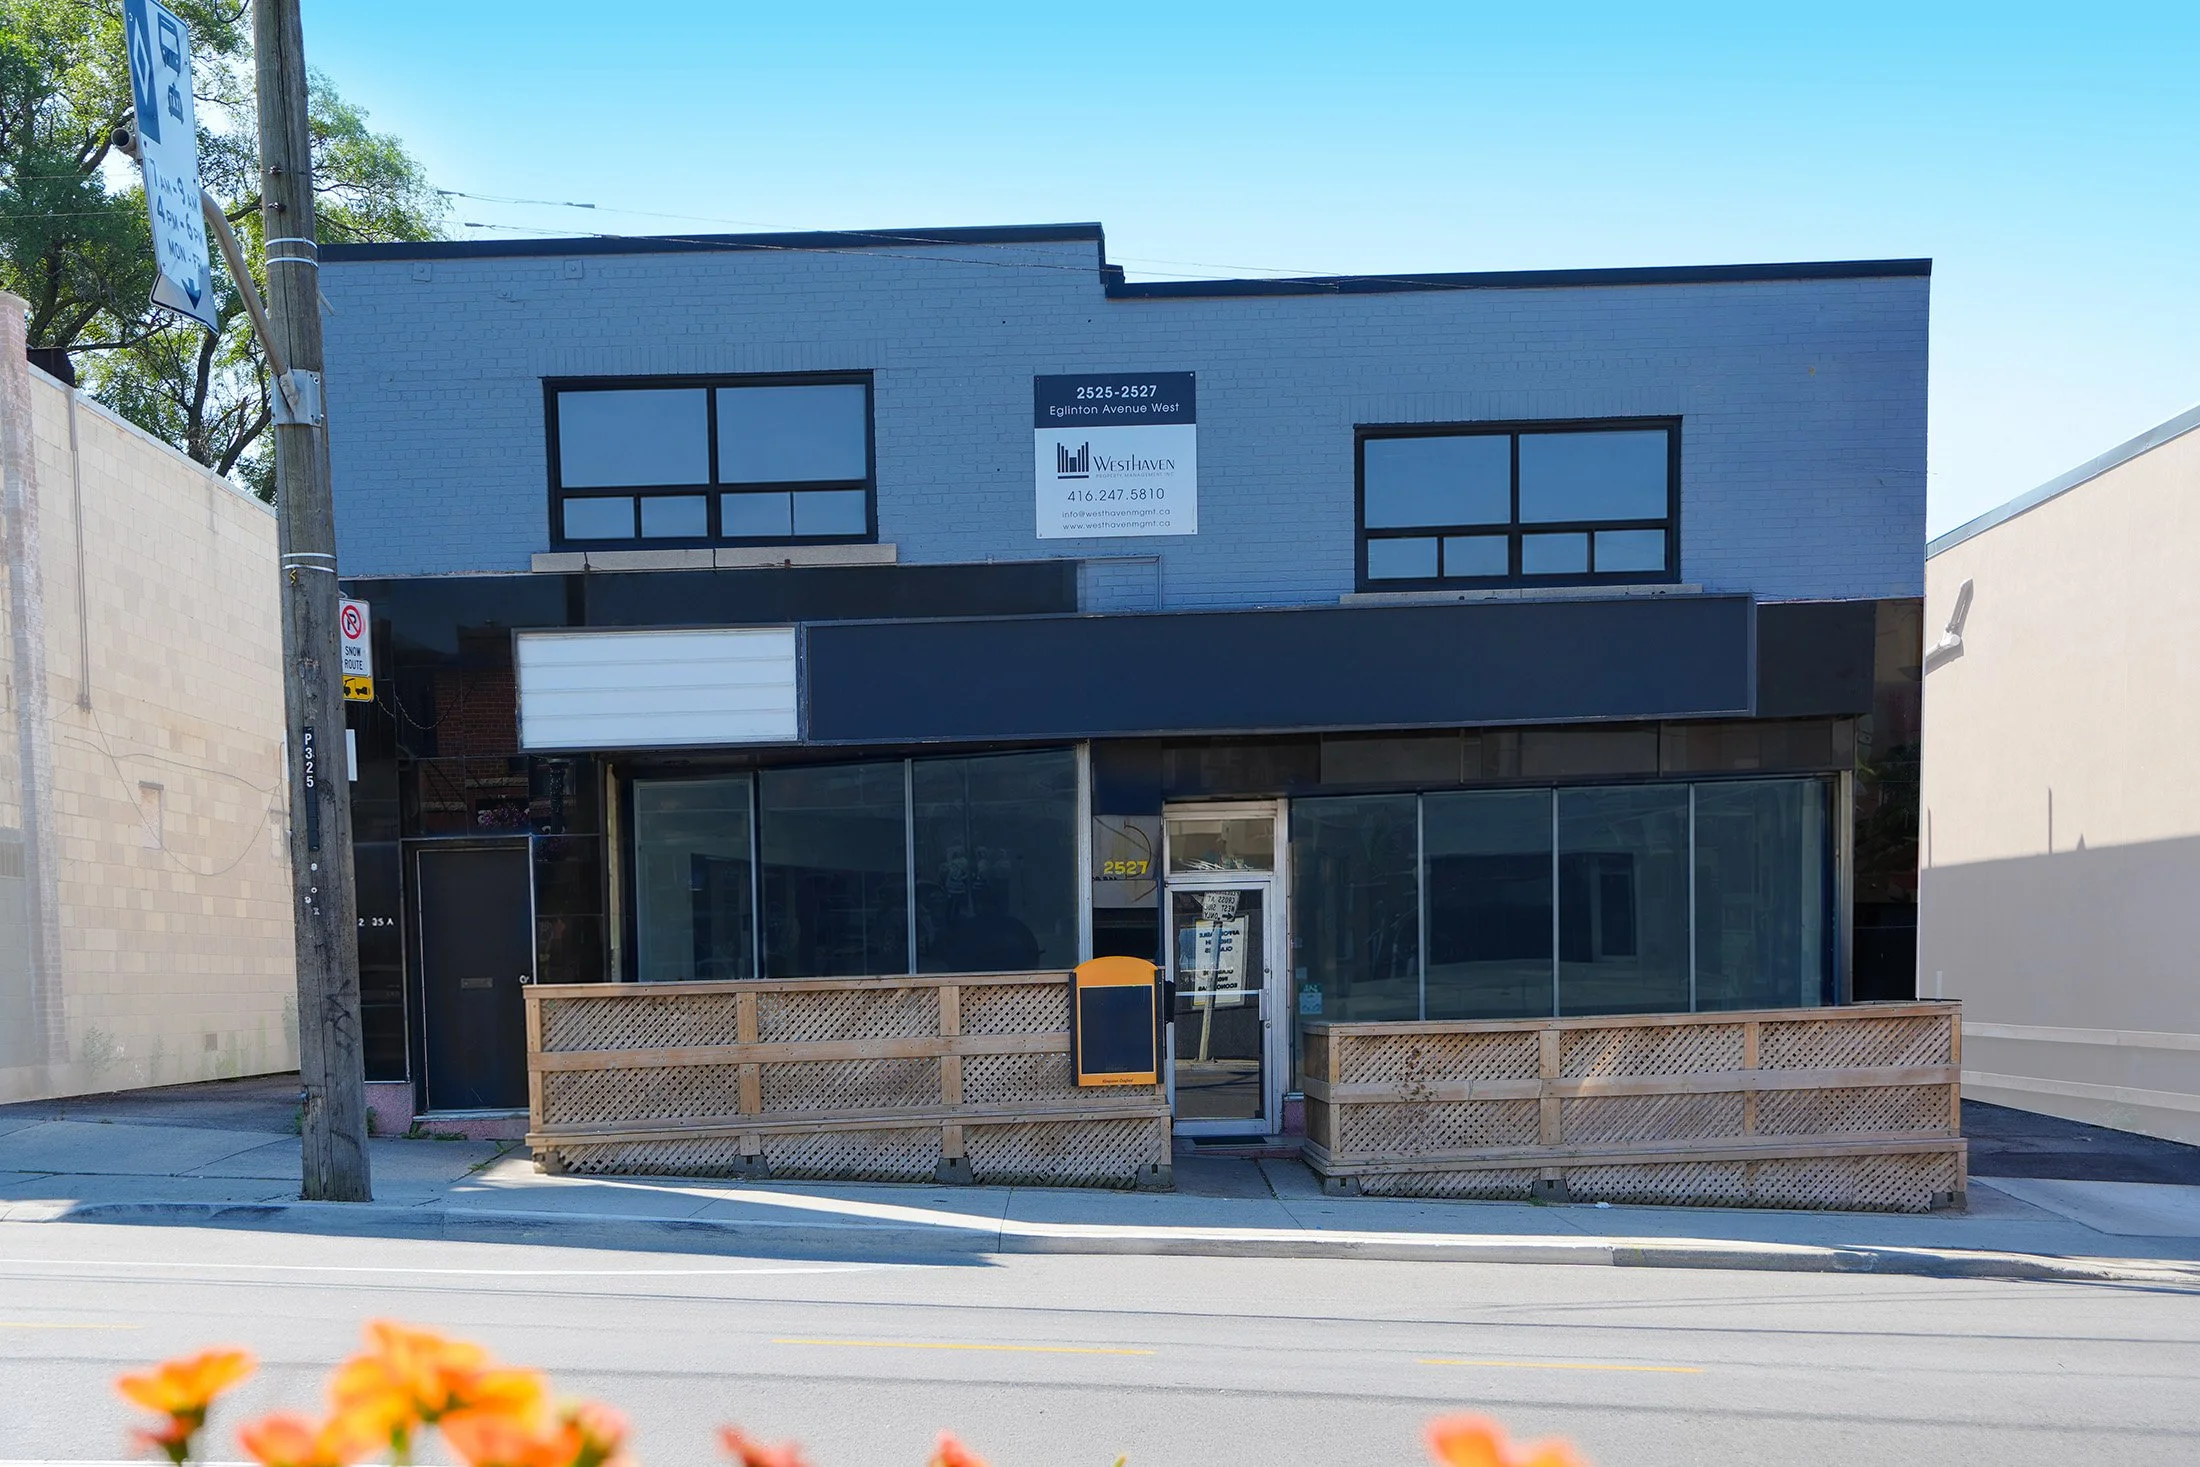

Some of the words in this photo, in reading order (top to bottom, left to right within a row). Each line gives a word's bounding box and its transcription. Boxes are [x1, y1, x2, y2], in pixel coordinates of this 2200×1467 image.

[1076, 385, 1157, 399] 2525-2527
[1049, 405, 1098, 417] Eglinton
[1102, 404, 1148, 414] Avenue
[1151, 402, 1180, 413] West
[1067, 488, 1165, 501] 416.247.5810
[1062, 508, 1171, 519] info@westhavenmgmt.ca
[1062, 520, 1171, 530] www.westhavenmgmt.ca
[345, 646, 361, 657] SNOW
[344, 659, 363, 670] ROUTE
[1103, 860, 1148, 875] 2527
